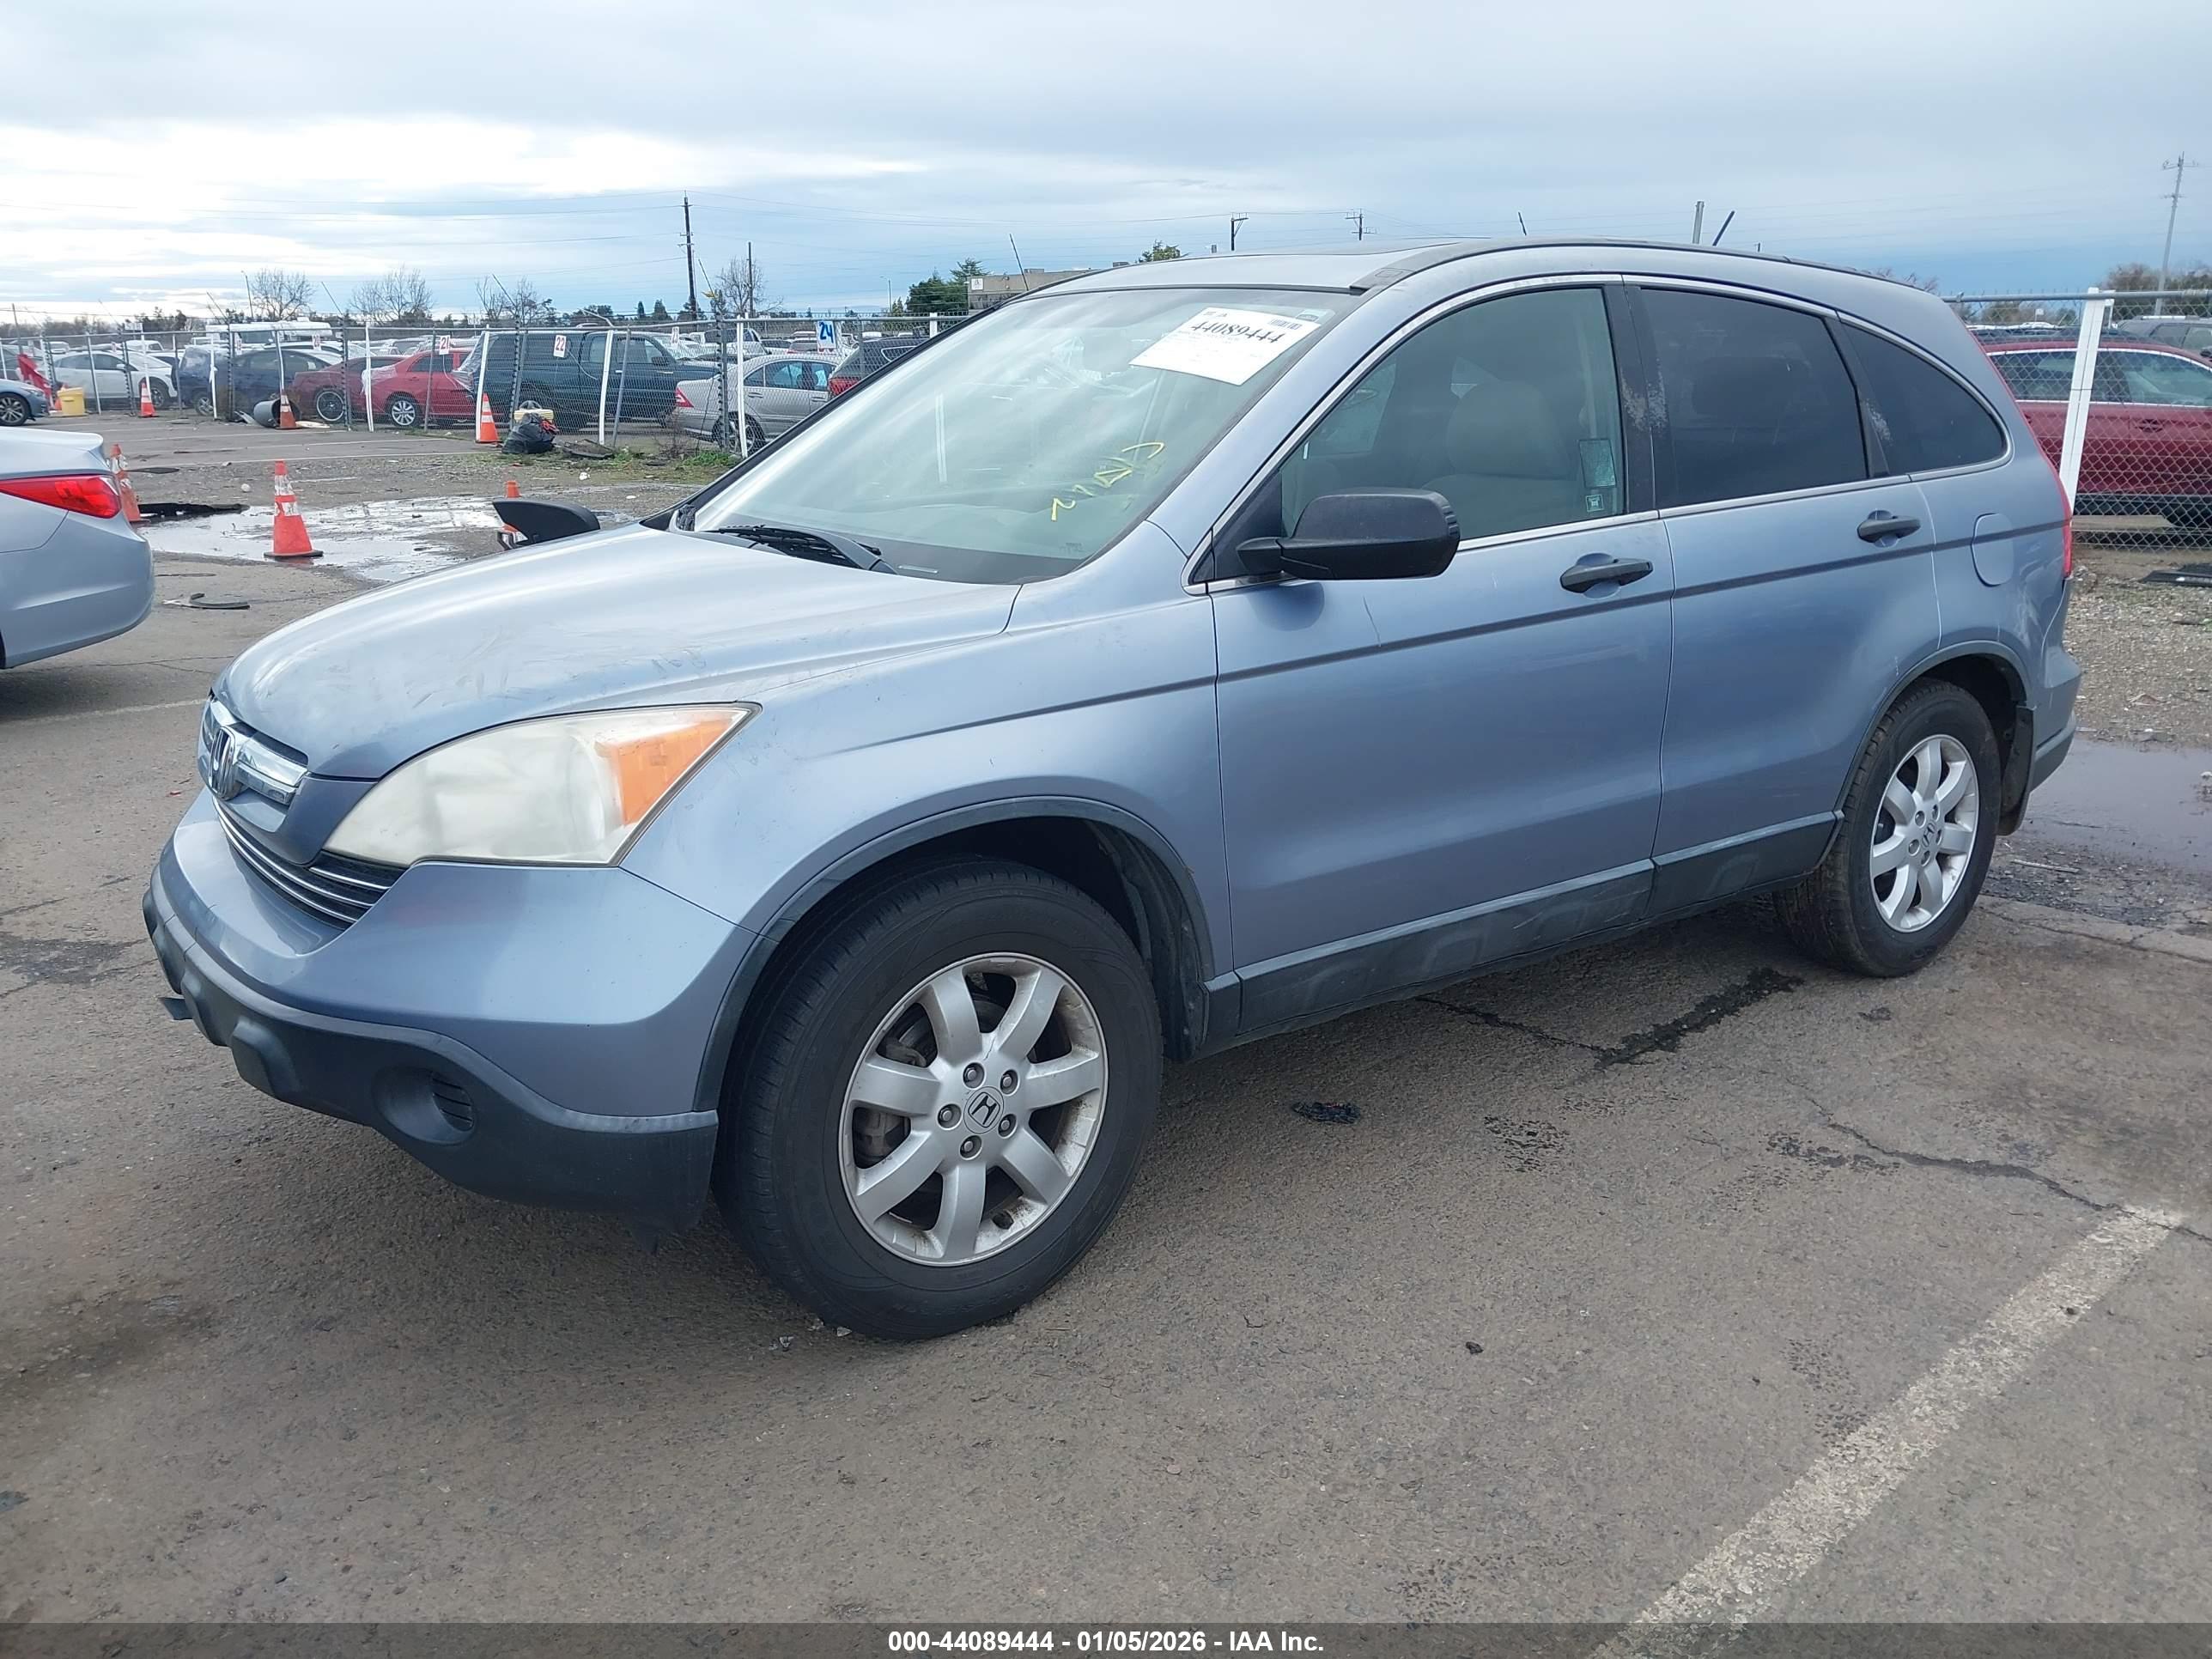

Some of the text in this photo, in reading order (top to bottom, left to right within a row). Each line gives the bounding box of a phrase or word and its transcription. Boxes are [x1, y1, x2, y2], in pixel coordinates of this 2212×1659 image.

[818, 321, 834, 343] 24
[1190, 320, 1286, 343] 44089444
[440, 336, 450, 349] 21
[555, 336, 565, 352] 22
